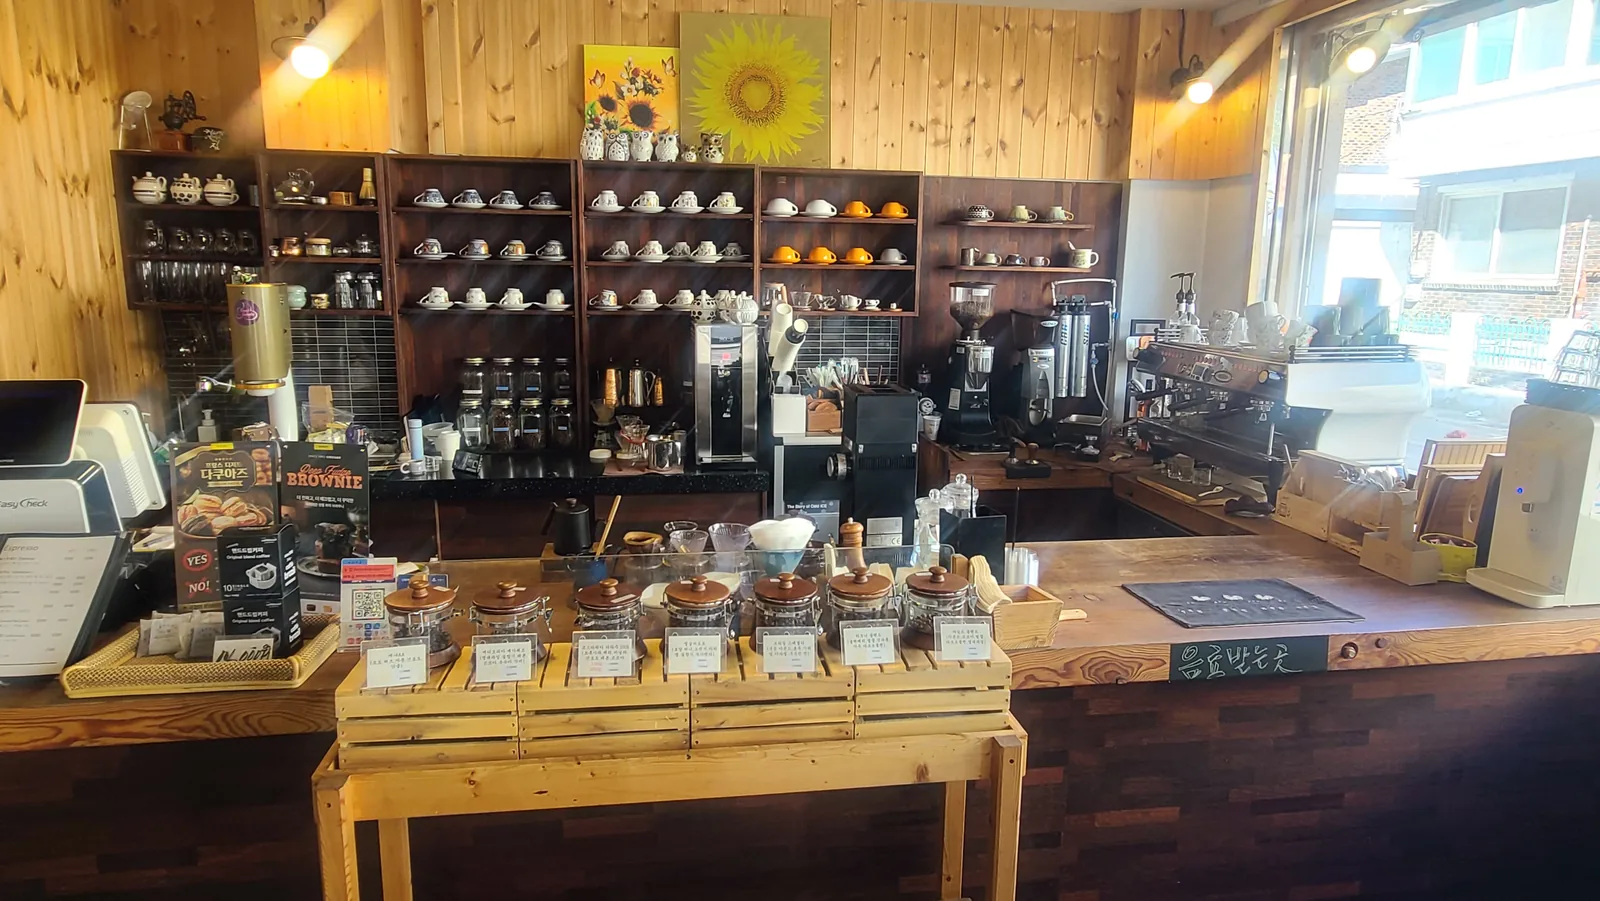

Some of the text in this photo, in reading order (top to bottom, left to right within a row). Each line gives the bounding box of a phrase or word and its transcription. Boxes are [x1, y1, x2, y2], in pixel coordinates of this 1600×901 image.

[200, 468, 249, 480] 다쿠아즈
[286, 472, 363, 490] BROWNIE
[187, 555, 208, 567] YES
[189, 581, 210, 594] NO!
[223, 584, 233, 592] 10
